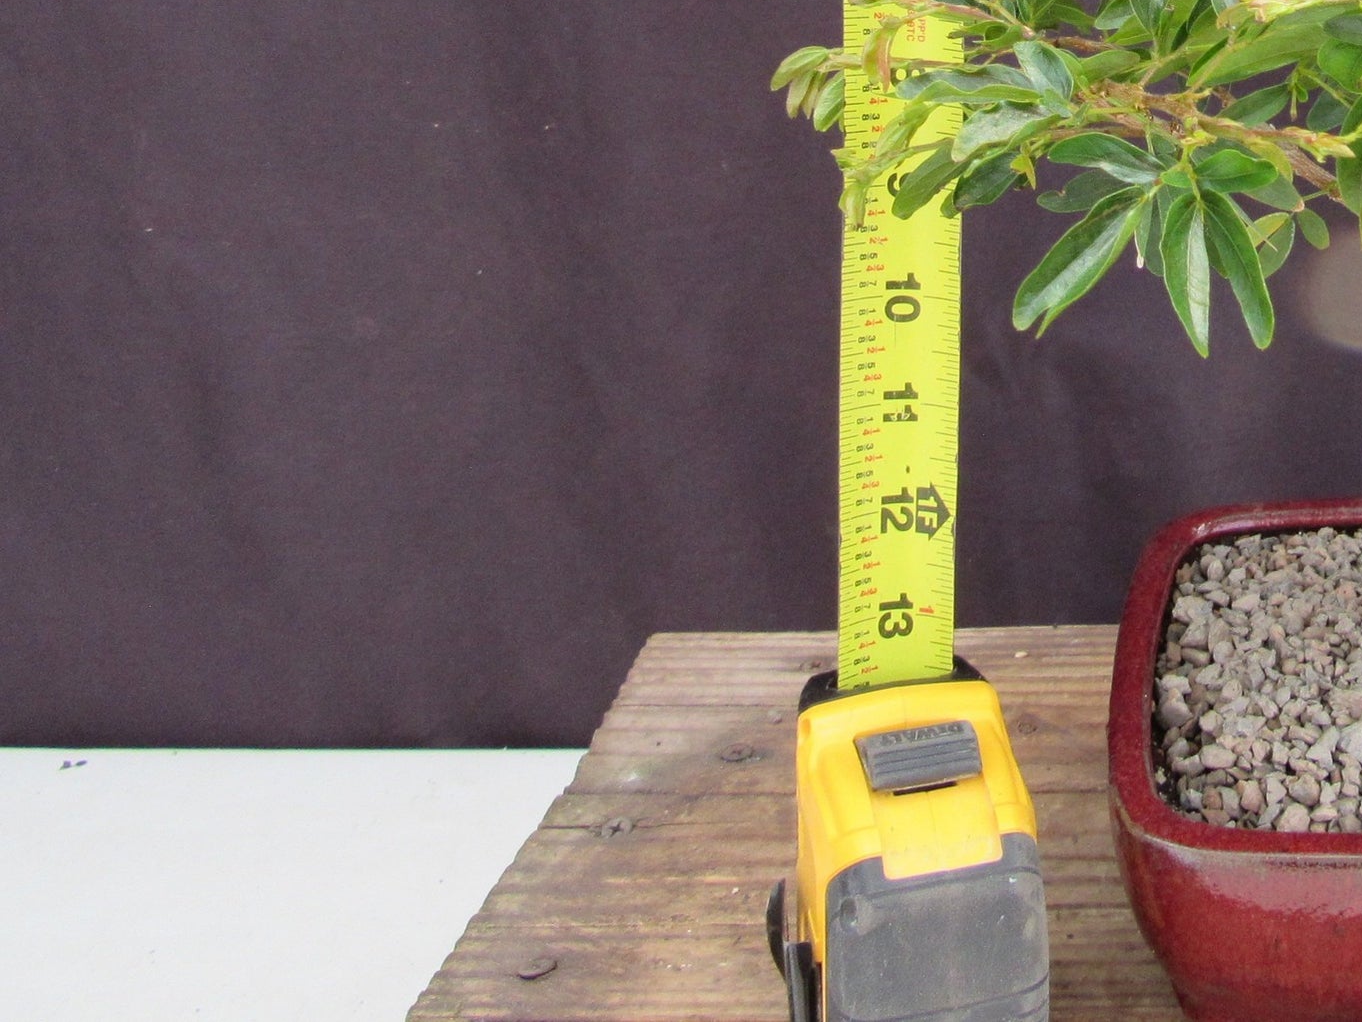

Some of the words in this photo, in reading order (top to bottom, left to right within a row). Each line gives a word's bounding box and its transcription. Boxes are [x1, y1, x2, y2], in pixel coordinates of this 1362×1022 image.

[884, 272, 921, 323] 10
[882, 382, 919, 423] 11
[880, 487, 914, 534] 12
[878, 592, 914, 639] 13
